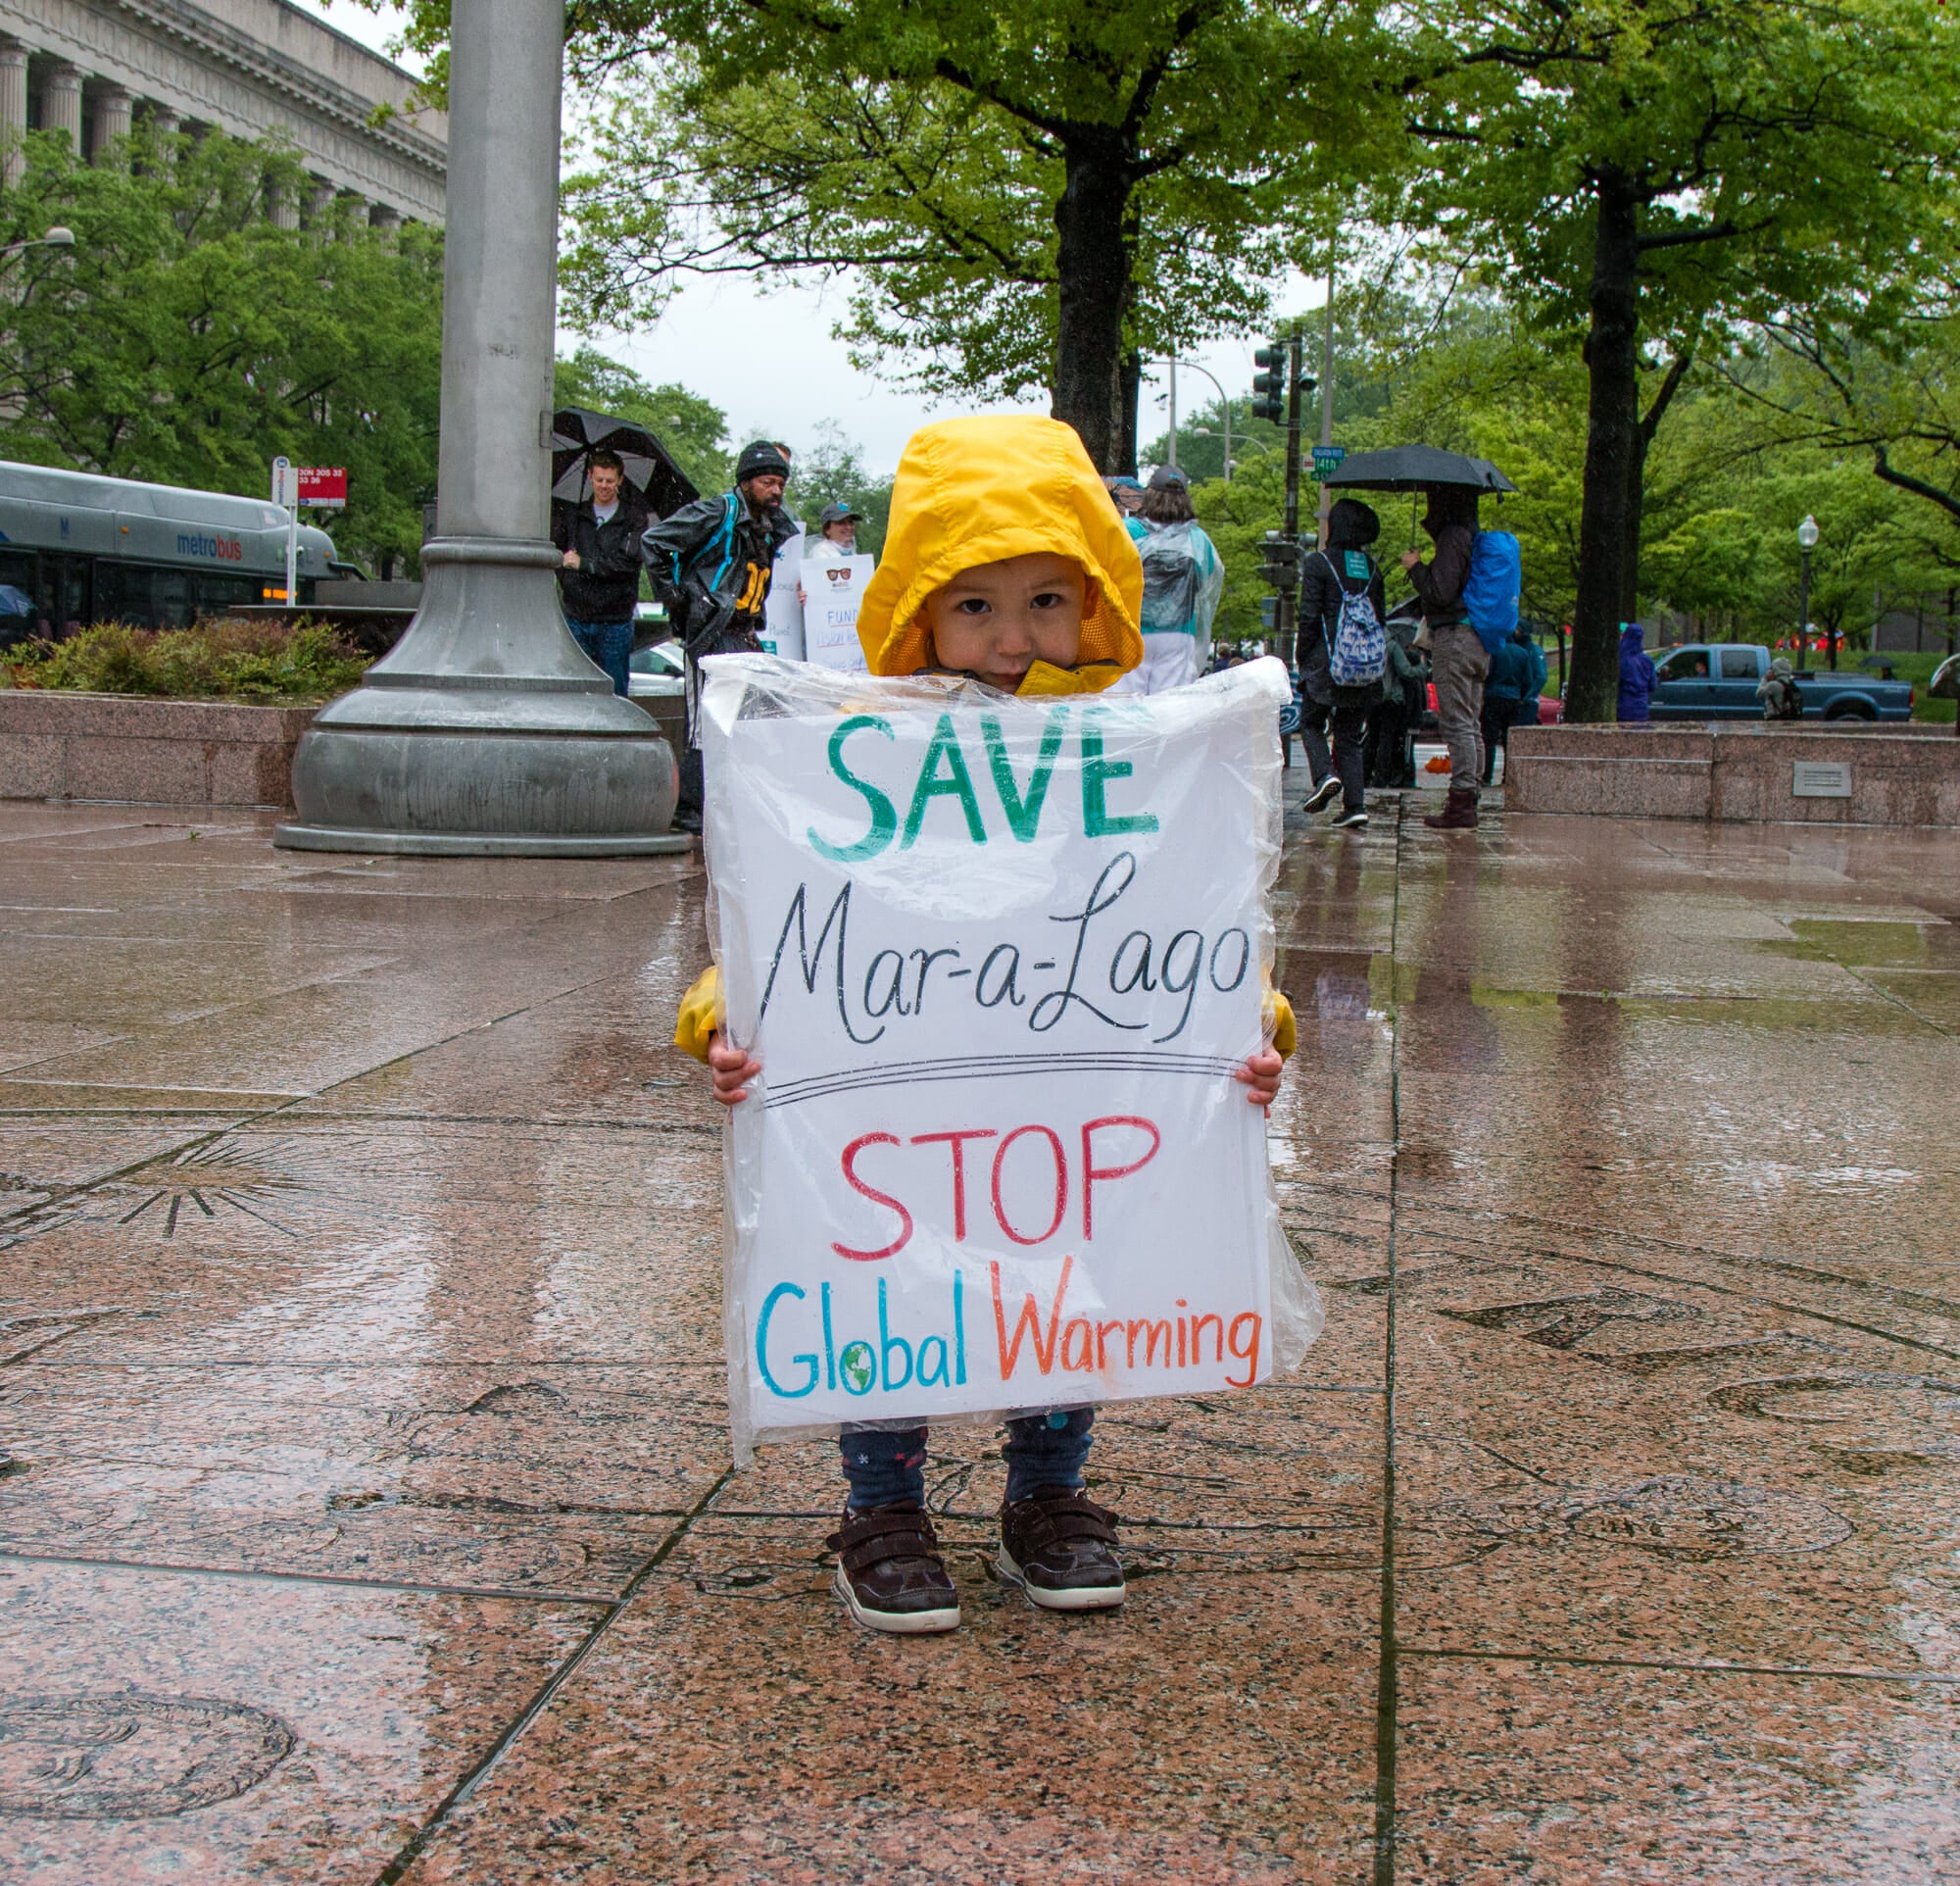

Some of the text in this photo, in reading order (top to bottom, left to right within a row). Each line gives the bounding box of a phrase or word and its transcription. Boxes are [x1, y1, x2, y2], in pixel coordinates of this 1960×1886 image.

[176, 532, 242, 561] metrobus
[807, 705, 1160, 864] SAVE
[760, 851, 1250, 1045] Mar-a-Lago
[831, 1116, 1161, 1262] STOP
[755, 1255, 1263, 1400] Global Warming
